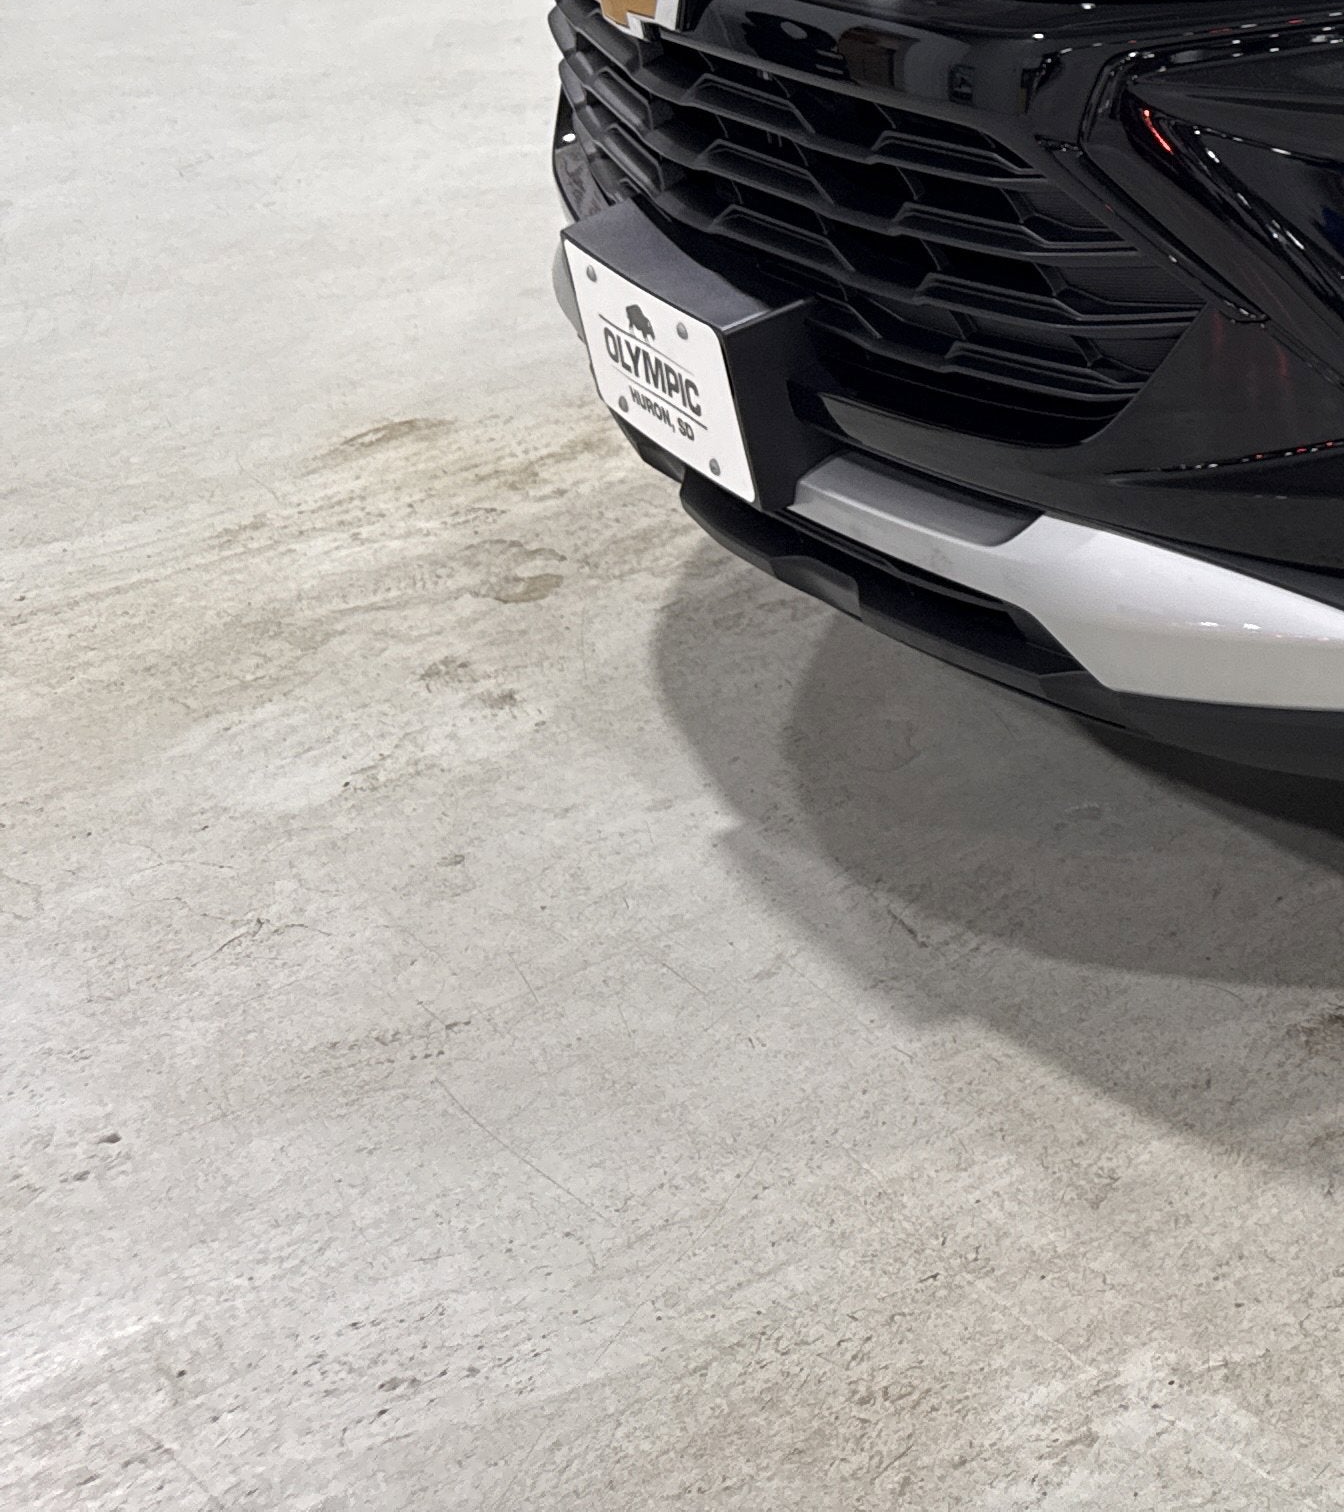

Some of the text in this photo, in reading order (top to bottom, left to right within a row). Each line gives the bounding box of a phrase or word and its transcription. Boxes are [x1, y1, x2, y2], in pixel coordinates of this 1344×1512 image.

[603, 326, 702, 417] OLYMPIC
[628, 384, 696, 442] HURON, SD
